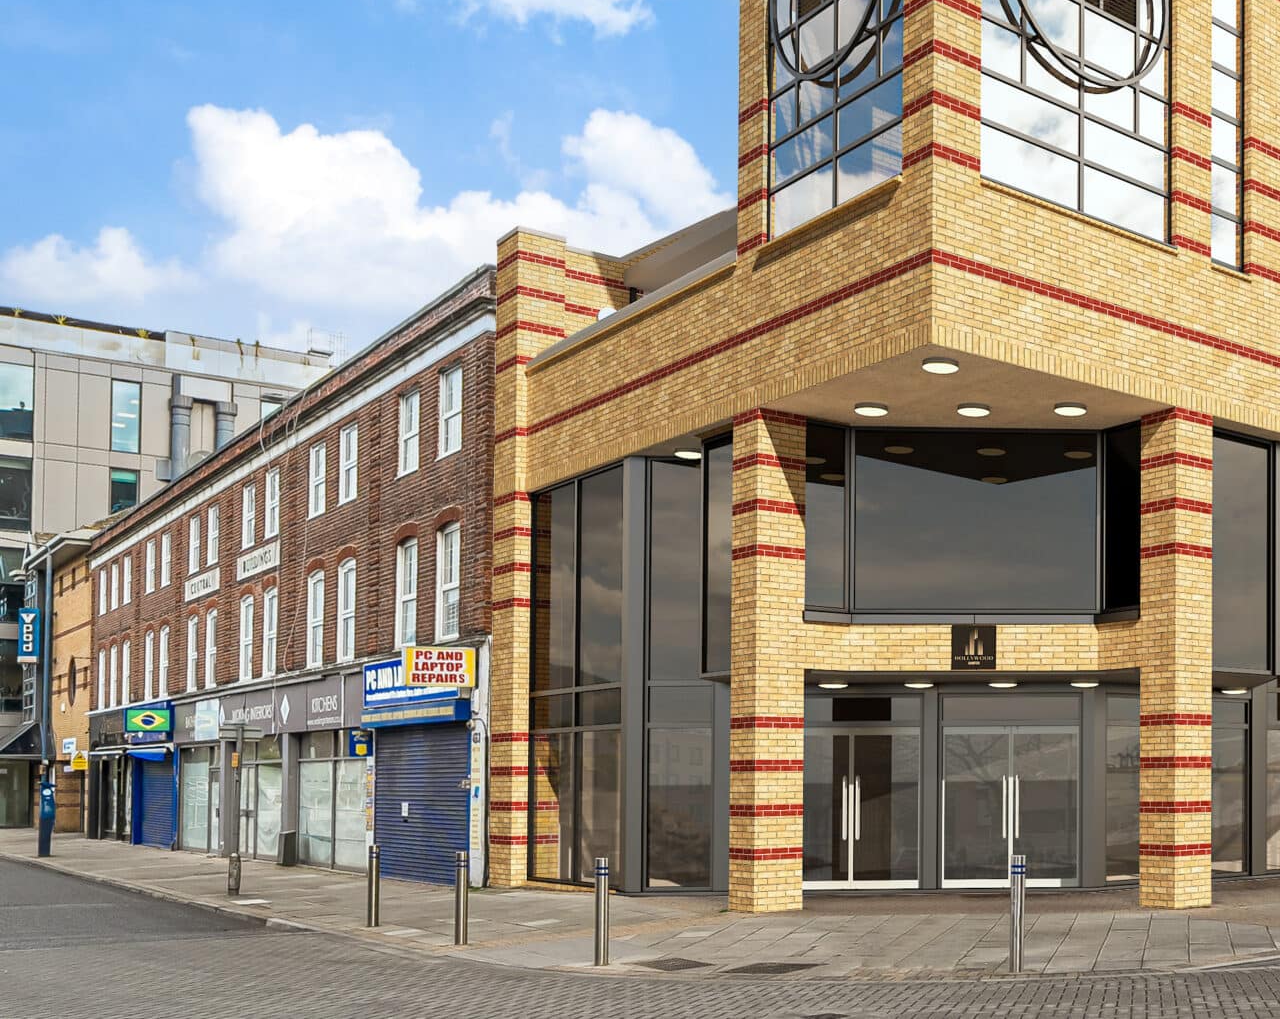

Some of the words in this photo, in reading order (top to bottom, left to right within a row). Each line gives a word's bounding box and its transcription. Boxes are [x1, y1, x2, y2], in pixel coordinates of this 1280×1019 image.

[415, 650, 433, 660] PC
[436, 651, 463, 661] AND
[414, 662, 464, 672] LAPTOP
[365, 669, 377, 691] PC
[377, 666, 393, 690] AND
[411, 673, 466, 684] REPAIRS
